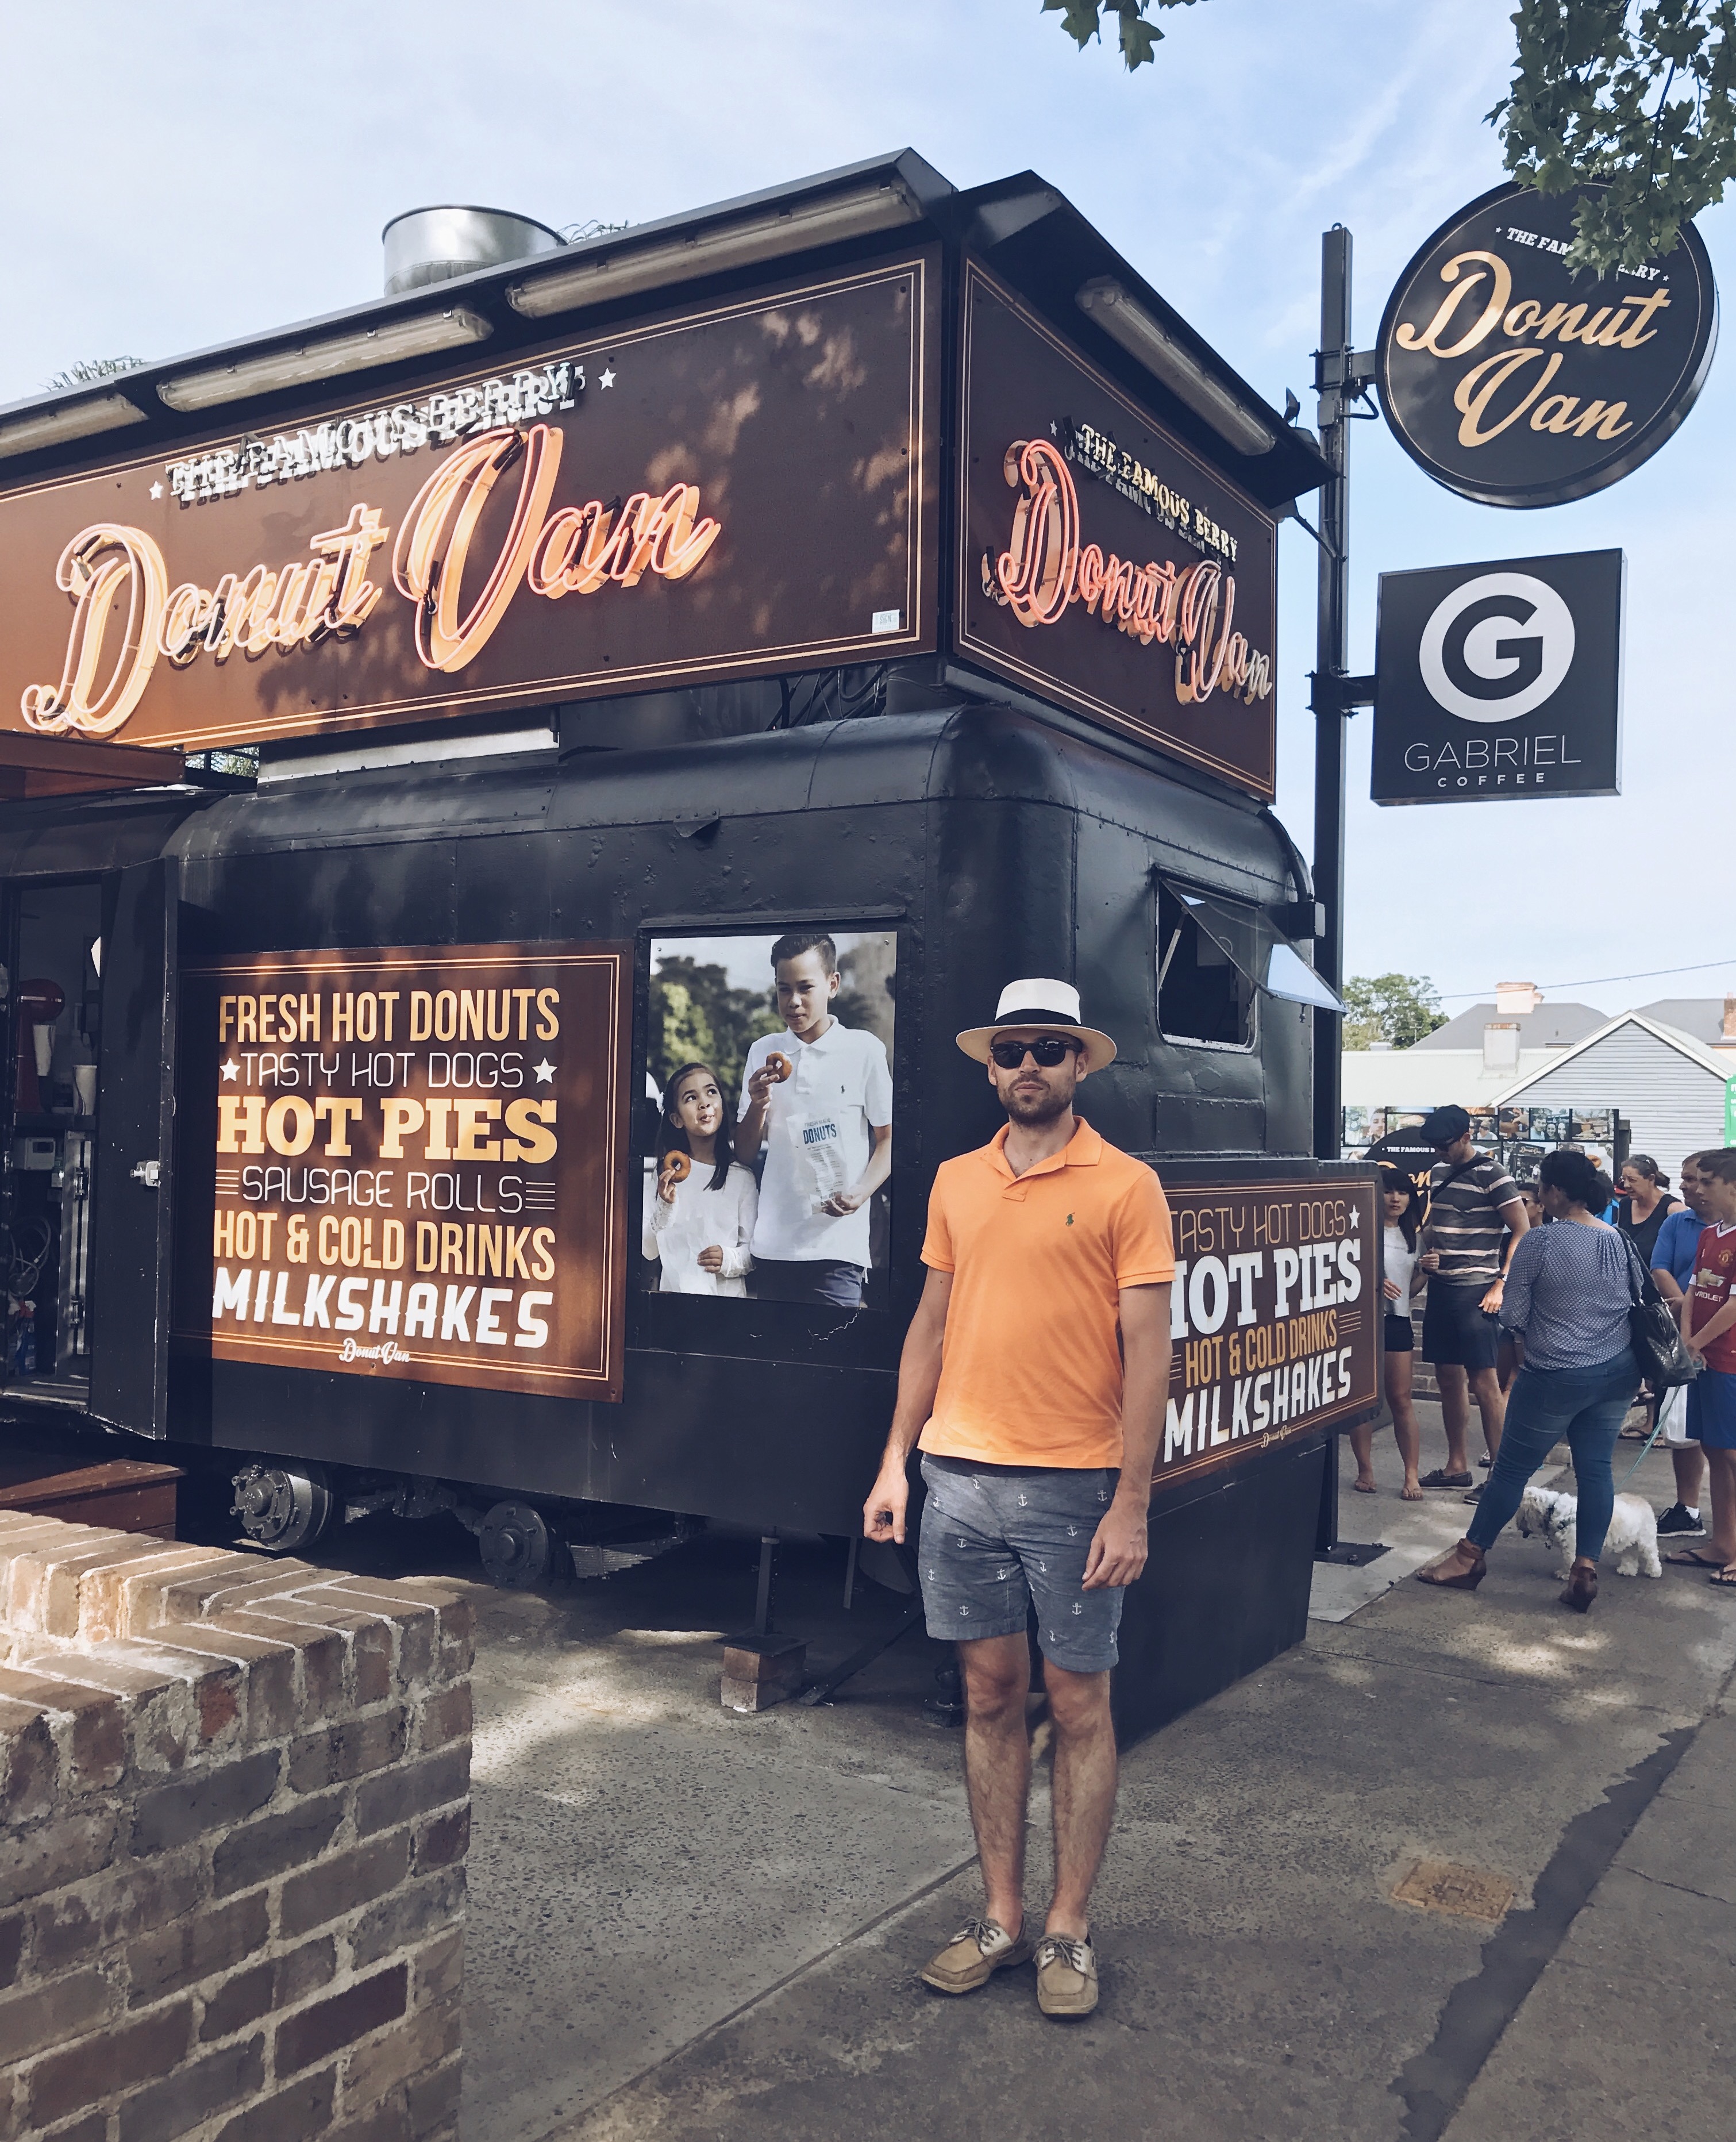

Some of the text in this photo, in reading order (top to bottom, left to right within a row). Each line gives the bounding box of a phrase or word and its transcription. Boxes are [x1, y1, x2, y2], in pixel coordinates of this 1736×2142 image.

[1507, 228, 1538, 247] THE
[1537, 238, 1574, 256] FAM
[1396, 251, 1671, 358] Donut
[165, 362, 576, 501] THE FAMOUS BERRY
[1454, 348, 1633, 447] Van
[1079, 424, 1238, 562] THE FAMOUS BERRY
[21, 424, 721, 733] Donut Van
[981, 439, 1272, 705] Donut Van
[1442, 595, 1543, 700] G
[1404, 735, 1581, 772] GABRIEL
[1438, 772, 1545, 787] COFFEE
[219, 988, 560, 1043] FRESH HOT DONUTS
[240, 1052, 524, 1088] TASTY HOT DOGS
[215, 1095, 557, 1164] HOT PIES
[802, 1124, 837, 1144] DONUTS
[242, 1166, 523, 1213] SAUSAGE ROLLS
[1253, 1203, 1292, 1246] HOT
[1299, 1199, 1346, 1241] DOGS
[213, 1209, 556, 1281] HOT & COLD DRINKS
[1273, 1238, 1362, 1318] PIES
[211, 1266, 554, 1348] MILKSHAKES
[1695, 1291, 1723, 1302] VROLET
[338, 1337, 411, 1365] Donut Van
[1185, 1309, 1337, 1389] HOT & COLD DRINKS
[1163, 1345, 1352, 1463] MILKSHAKES
